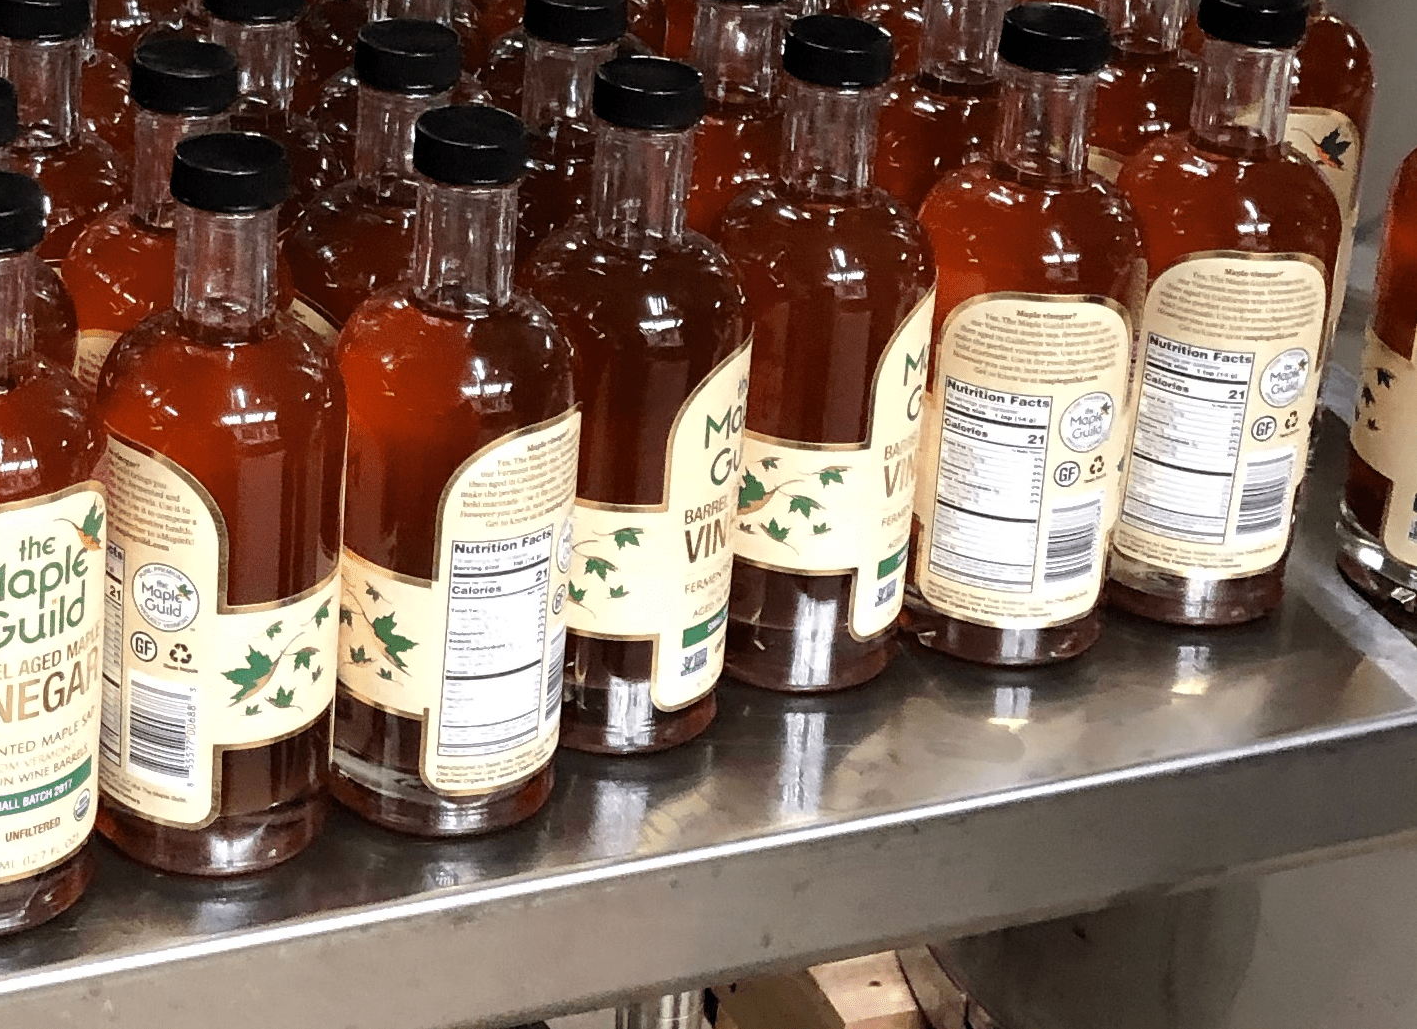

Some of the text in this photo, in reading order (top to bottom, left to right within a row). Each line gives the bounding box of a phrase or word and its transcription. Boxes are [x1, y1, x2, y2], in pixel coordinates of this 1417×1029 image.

[1149, 335, 1252, 364] Nutrition Facts
[947, 379, 1050, 408] Nutrition Facts
[1144, 372, 1245, 400] Calories 21
[944, 417, 1045, 445] Calories 21
[1256, 421, 1273, 436] GF
[1059, 466, 1076, 482] GF
[684, 495, 728, 525] BARRE
[19, 536, 56, 562] the
[454, 530, 552, 554] Nutrition Facts
[535, 568, 548, 582] 21
[110, 585, 121, 600] 21
[142, 581, 182, 604] Maple
[452, 586, 502, 595] Calories
[145, 598, 181, 617] Guild
[18, 649, 62, 677] AGED
[66, 620, 100, 661] MAPLE
[136, 637, 152, 656] GF
[41, 721, 79, 748] MAPLE
[0, 777, 14, 786] IN
[18, 766, 50, 783] WINE
[53, 743, 89, 772] BARRELS
[23, 788, 53, 807] BATCH
[54, 778, 73, 797] 2017
[5, 817, 61, 842] UNFILTERED
